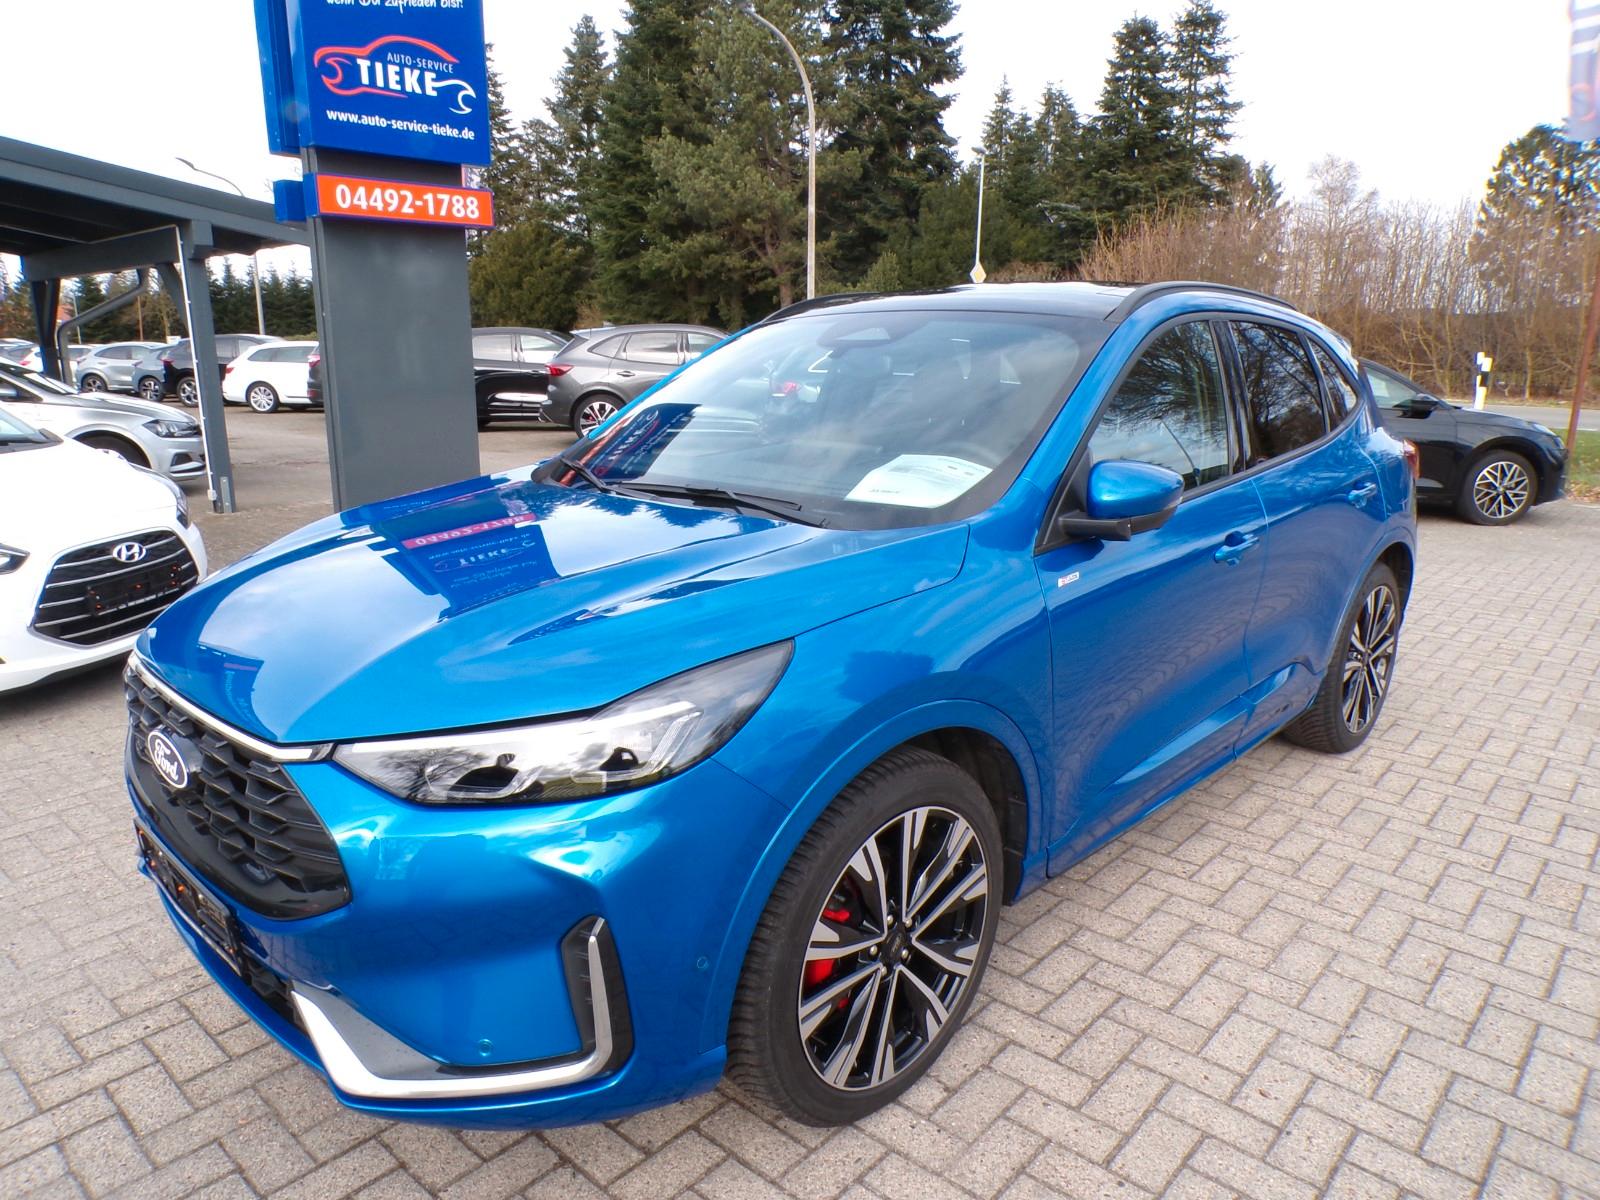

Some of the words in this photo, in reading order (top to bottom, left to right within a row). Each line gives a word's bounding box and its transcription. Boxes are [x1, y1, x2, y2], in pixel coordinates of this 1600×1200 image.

[357, 58, 437, 97] TIEKE
[387, 52, 454, 74] AUTO-SERVICE
[326, 109, 475, 141] www.auto-service-tieke.de
[335, 183, 480, 219] 04492-1788
[153, 738, 180, 782] Ford
